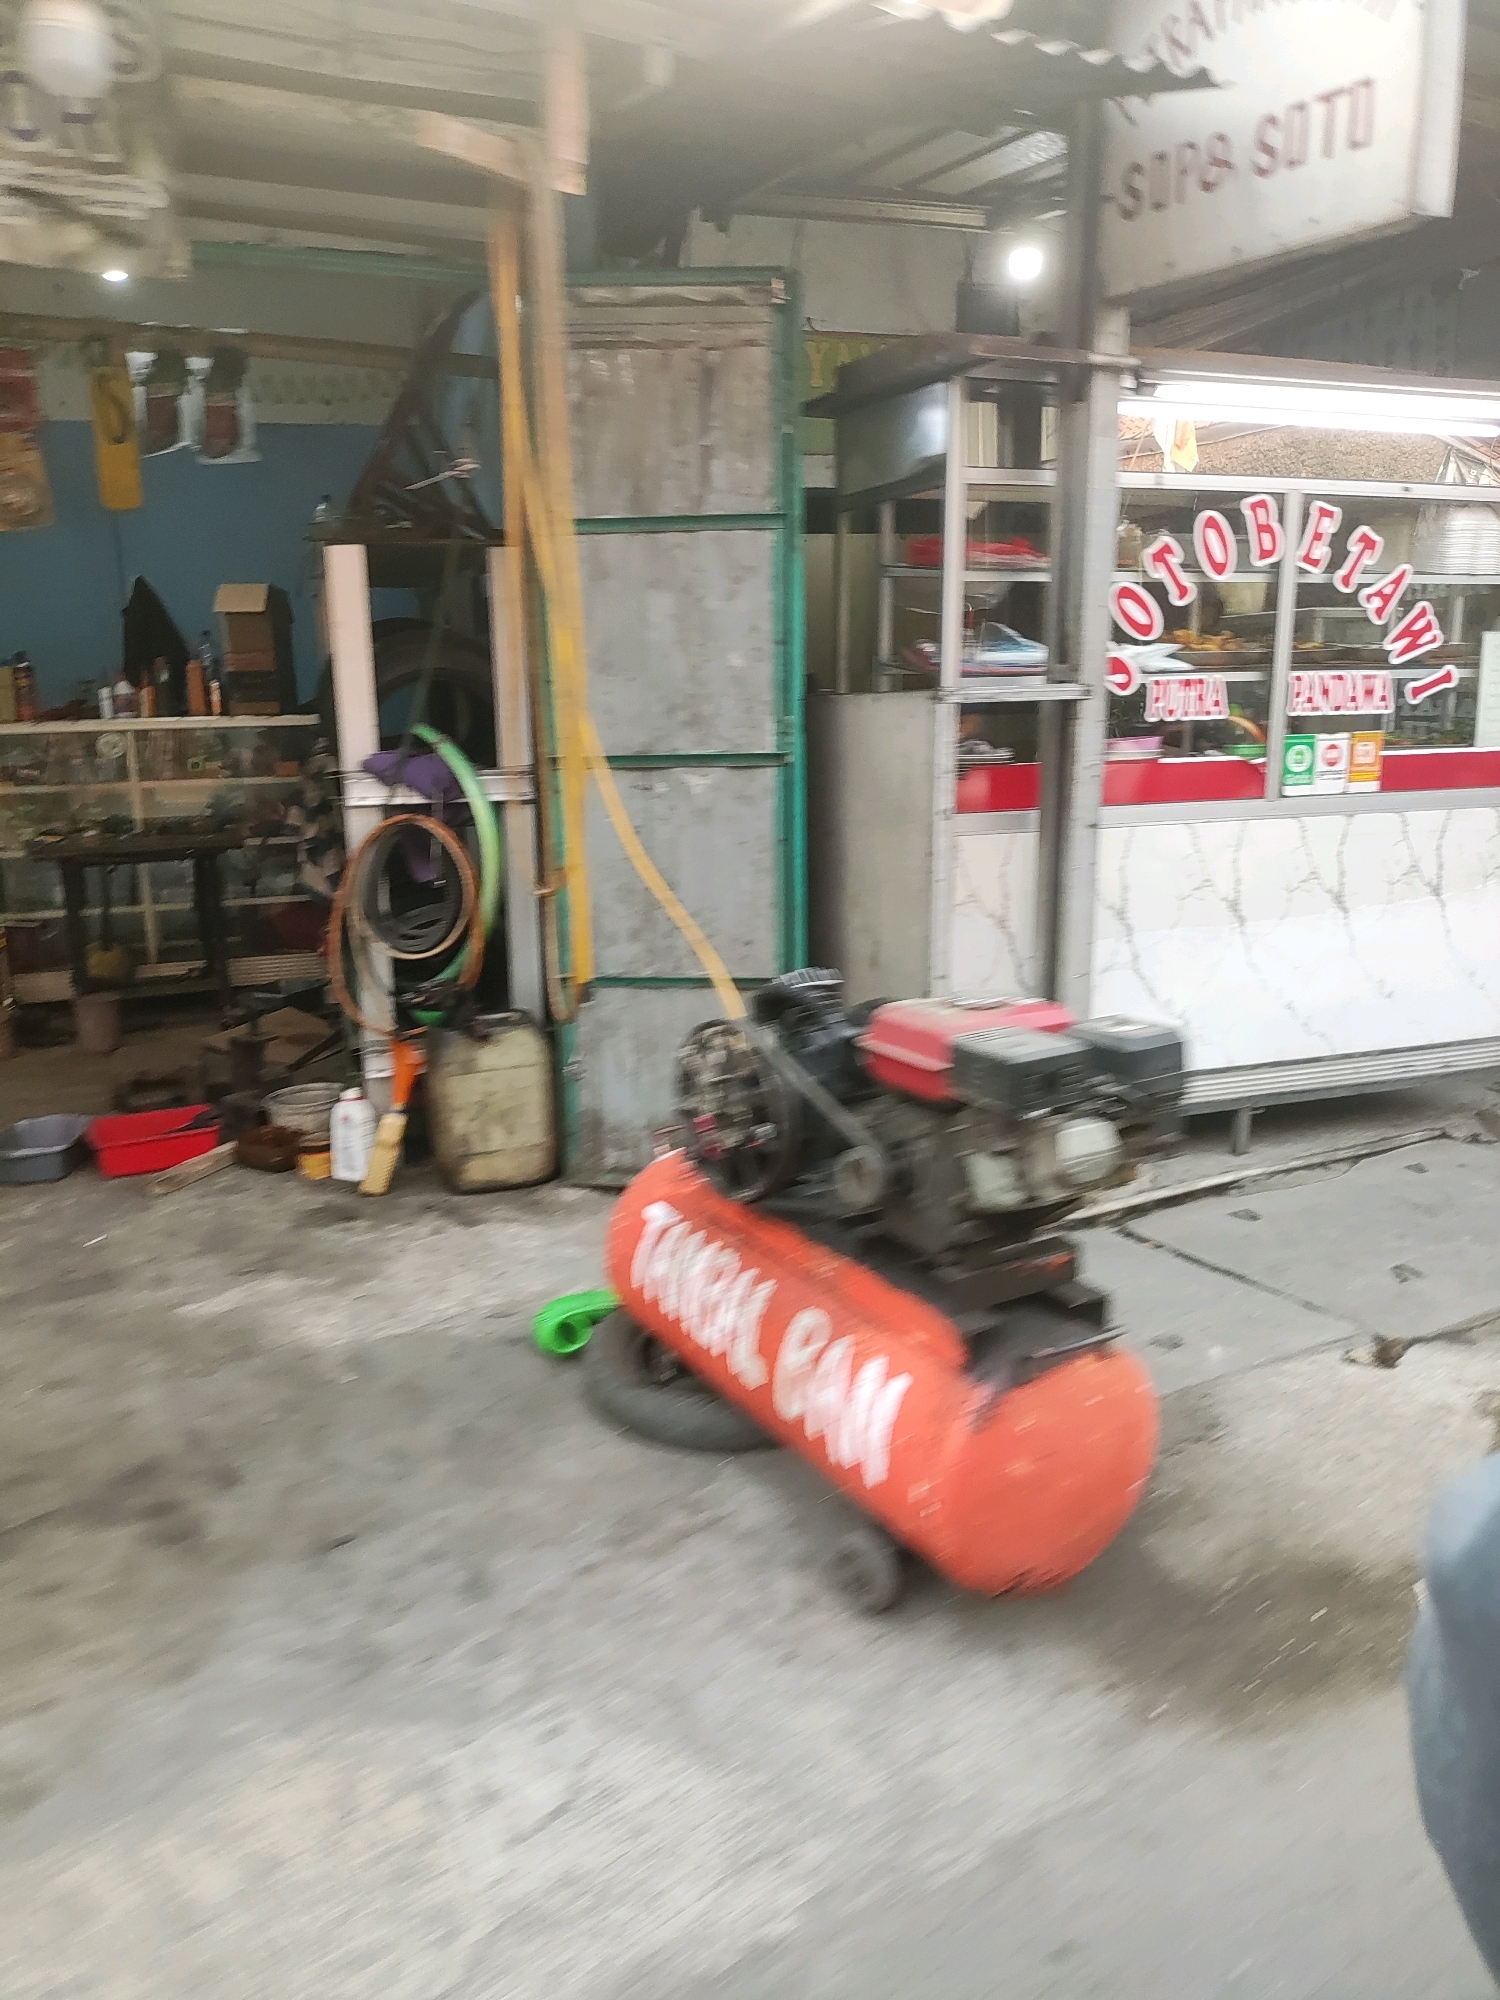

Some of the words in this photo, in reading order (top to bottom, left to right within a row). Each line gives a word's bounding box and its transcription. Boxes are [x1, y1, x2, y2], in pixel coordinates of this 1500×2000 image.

[1253, 77, 1376, 179] SOTO
[1240, 493, 1460, 705] BETAWI
[1145, 676, 1229, 721] PUTRA
[1287, 671, 1395, 716] PANDAWA
